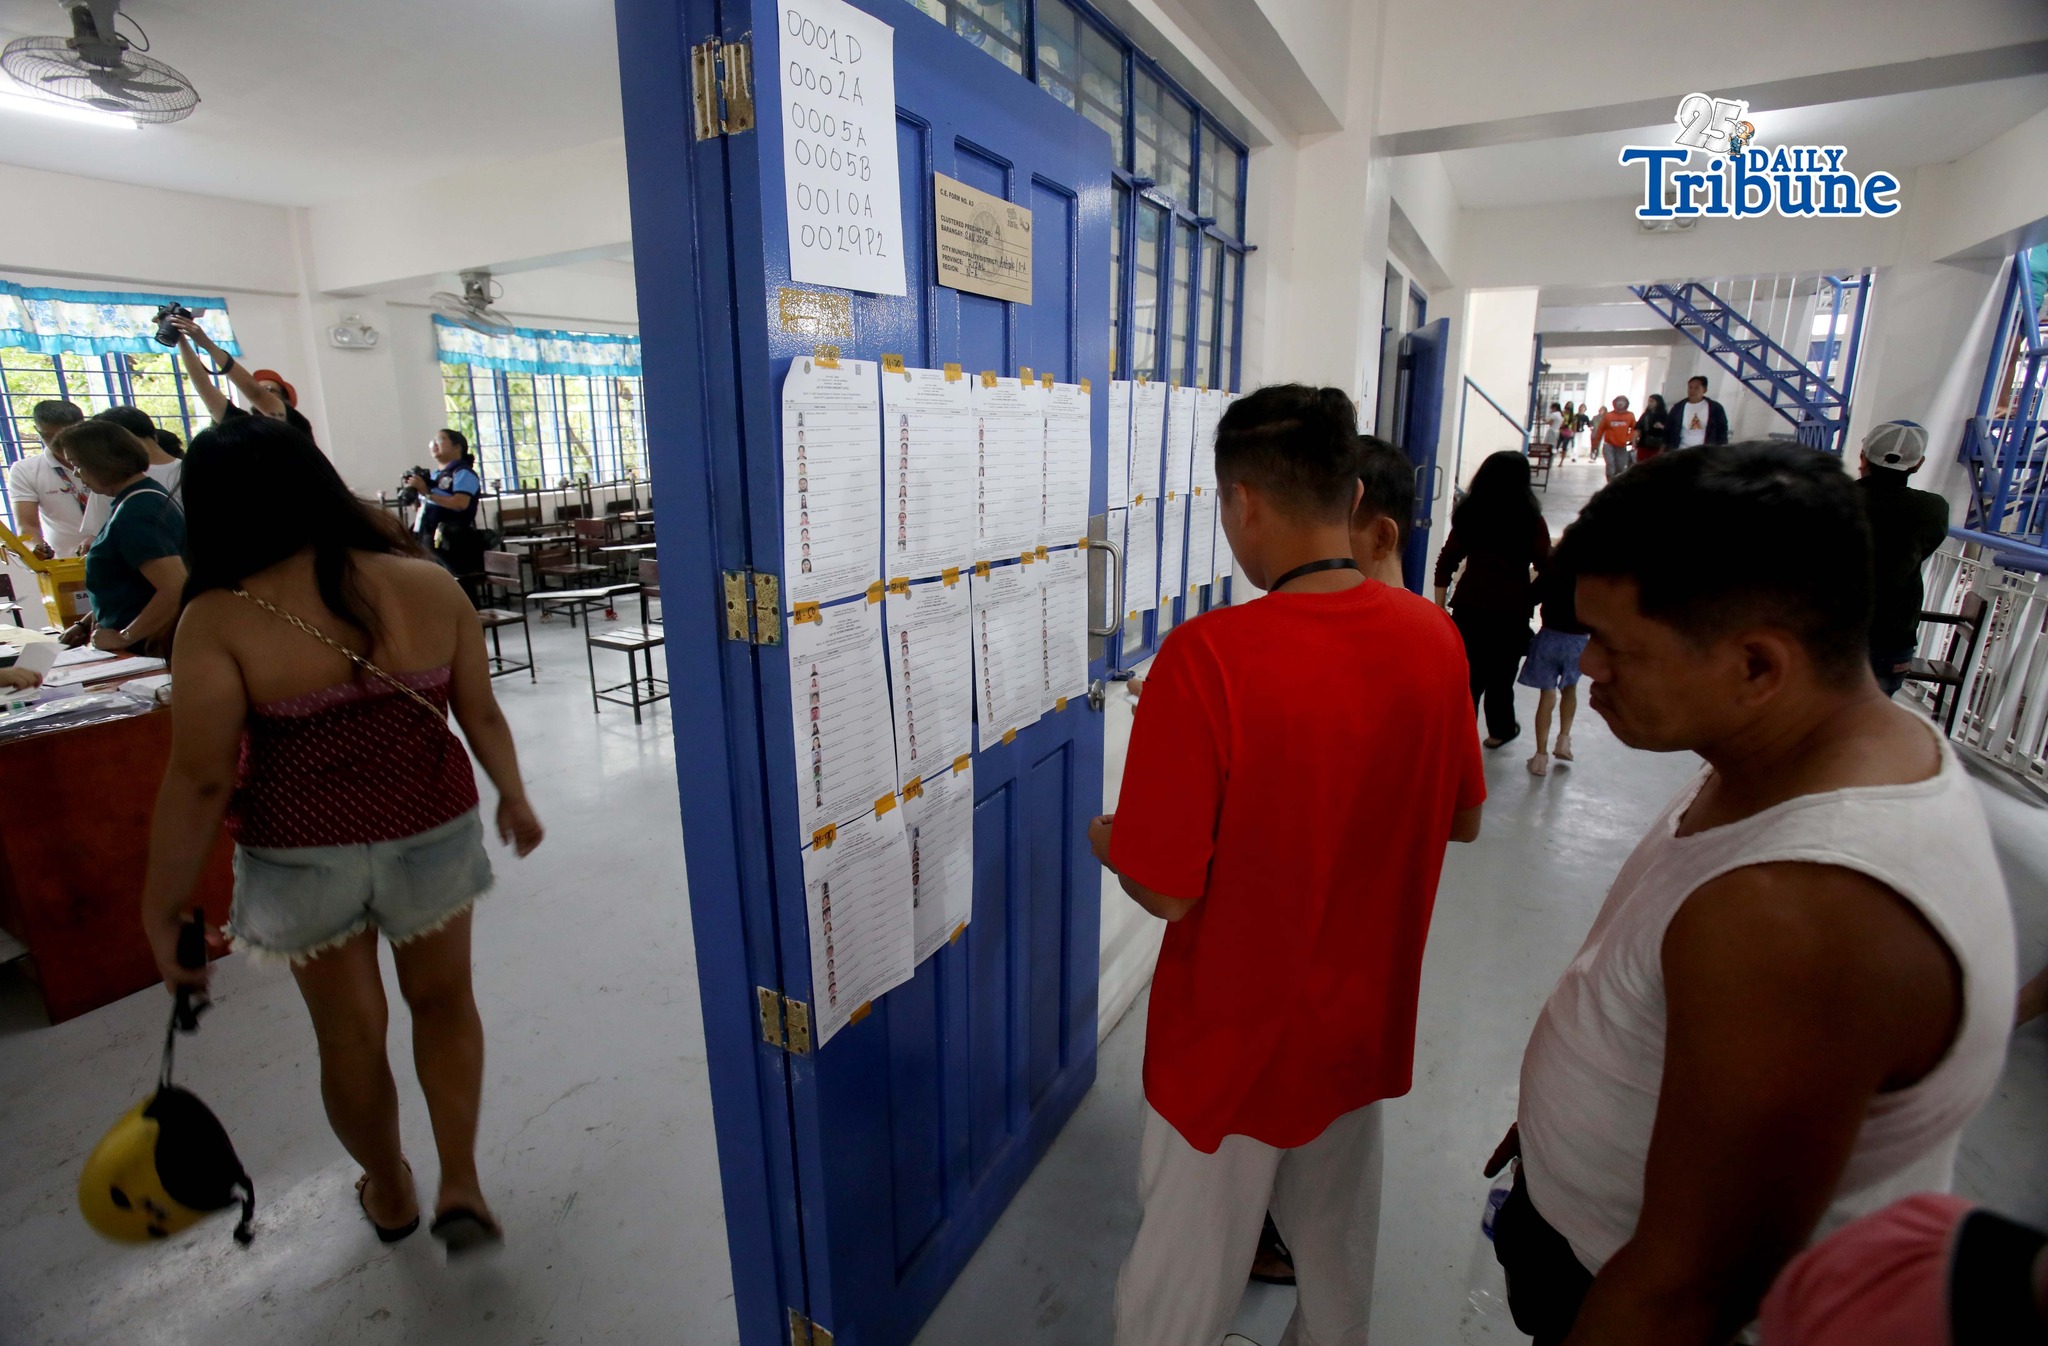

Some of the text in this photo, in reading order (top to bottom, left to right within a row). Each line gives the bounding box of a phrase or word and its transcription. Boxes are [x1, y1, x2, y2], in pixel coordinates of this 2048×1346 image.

[789, 61, 864, 106] 0002A
[792, 102, 867, 148] 0005A
[795, 139, 871, 182] 0005B
[797, 182, 873, 219] 0010A
[949, 191, 961, 202] FORM
[801, 225, 887, 258] 0029P2
[940, 214, 965, 229] CLUSTERED
[964, 223, 985, 235] PRECINCT
